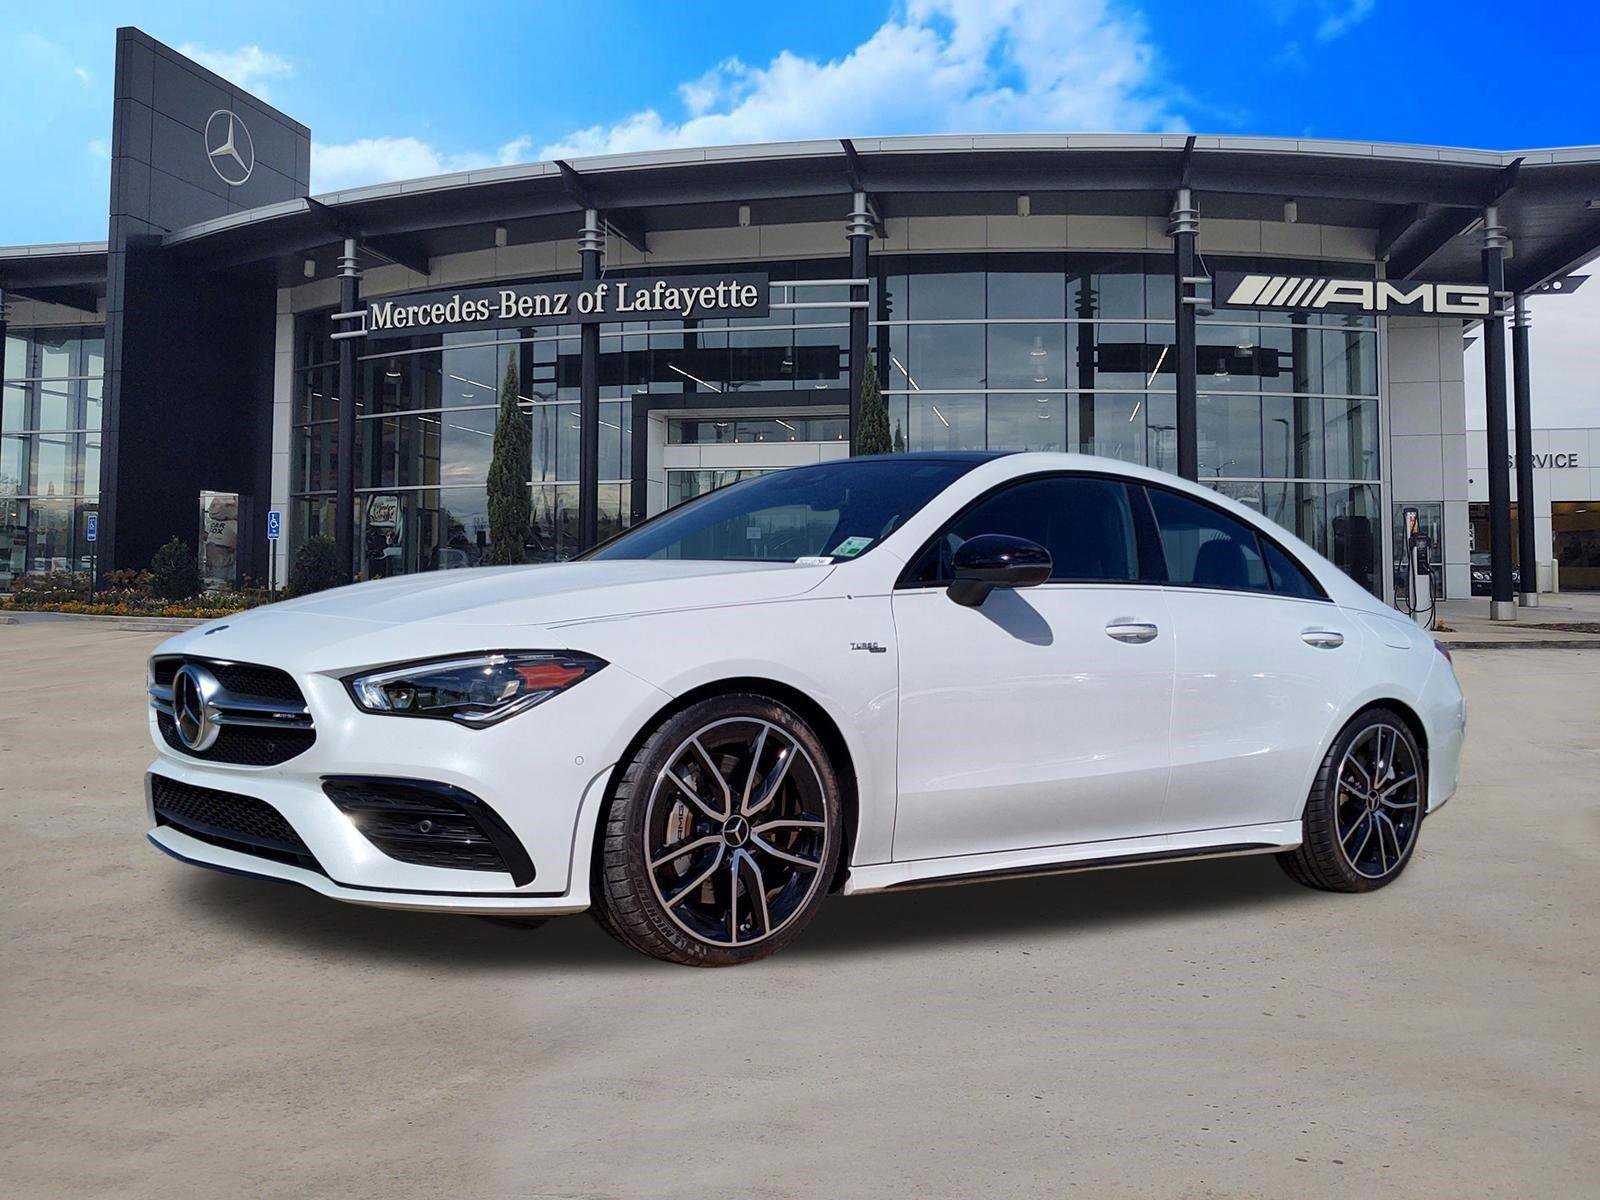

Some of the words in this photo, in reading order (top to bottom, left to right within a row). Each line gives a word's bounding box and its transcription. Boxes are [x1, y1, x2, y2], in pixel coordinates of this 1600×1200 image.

[369, 290, 568, 331] Mercedes-Benz
[576, 283, 608, 314] of
[615, 279, 758, 317] Lafayette
[1312, 279, 1490, 315] AMG
[1507, 453, 1578, 468] SRVICE
